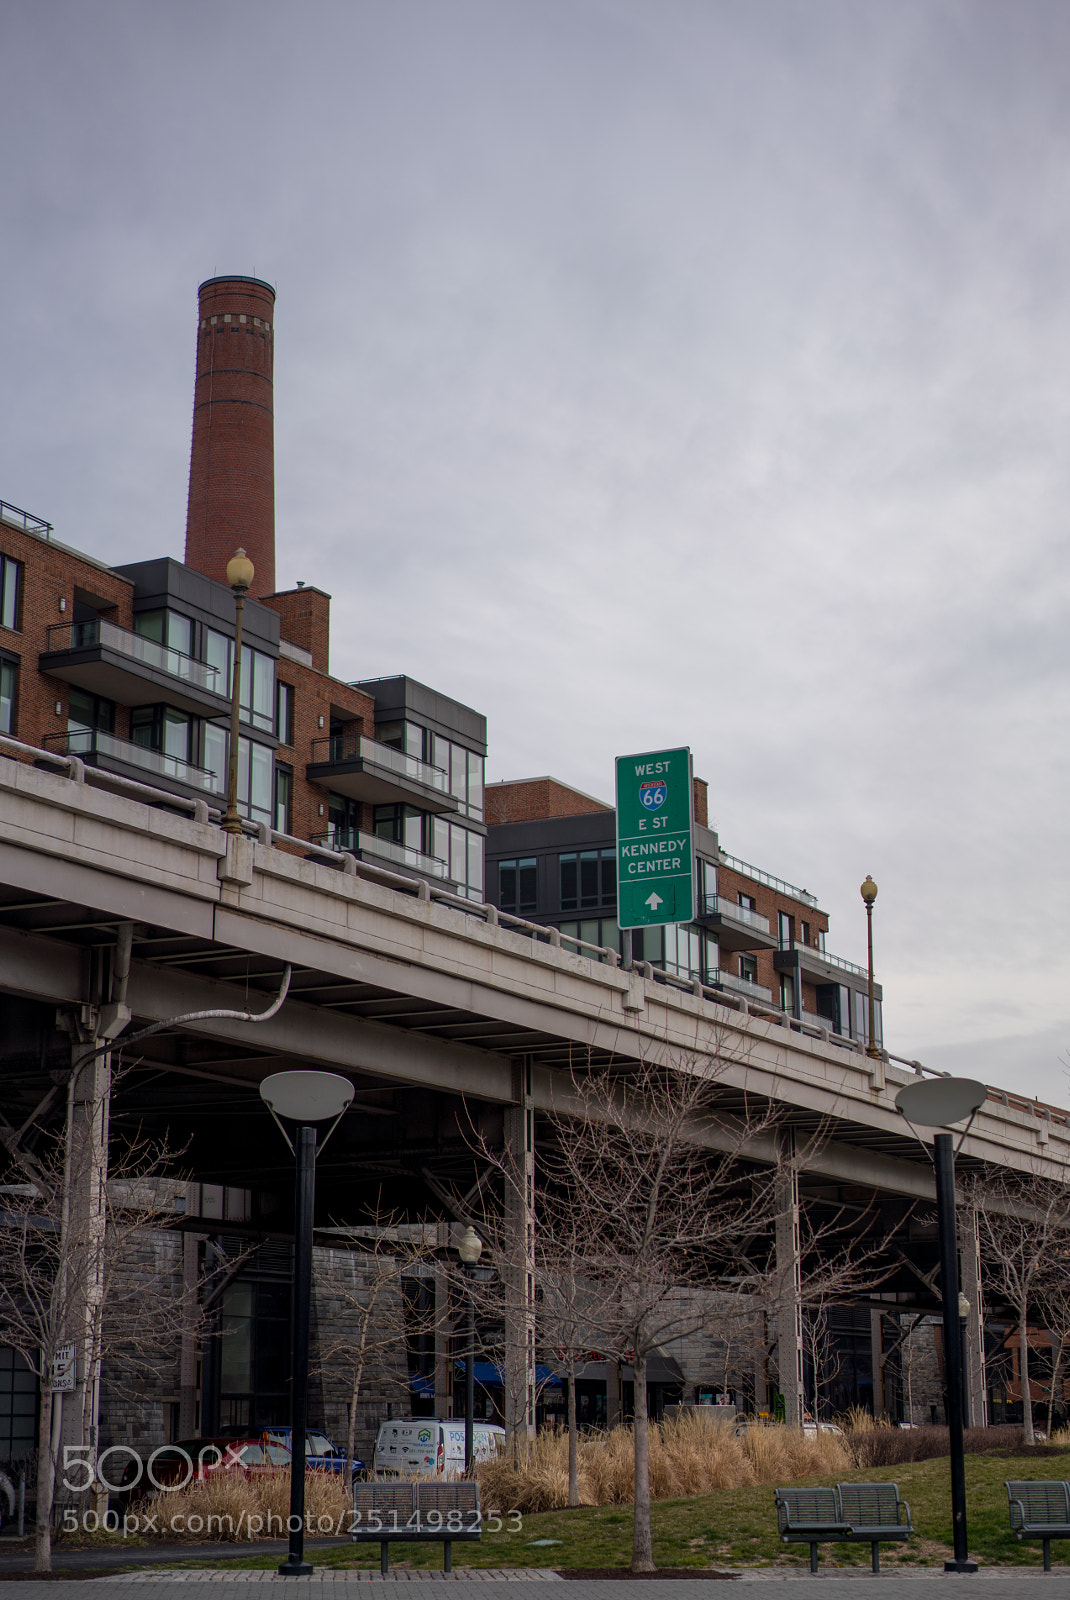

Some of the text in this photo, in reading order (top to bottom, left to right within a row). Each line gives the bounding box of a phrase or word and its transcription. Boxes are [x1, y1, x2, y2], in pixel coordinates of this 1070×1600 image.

[635, 761, 671, 777] WEST
[643, 788, 664, 806] 66
[639, 816, 669, 830] E ST
[621, 839, 687, 858] KENNEDY
[628, 857, 681, 874] CENTER
